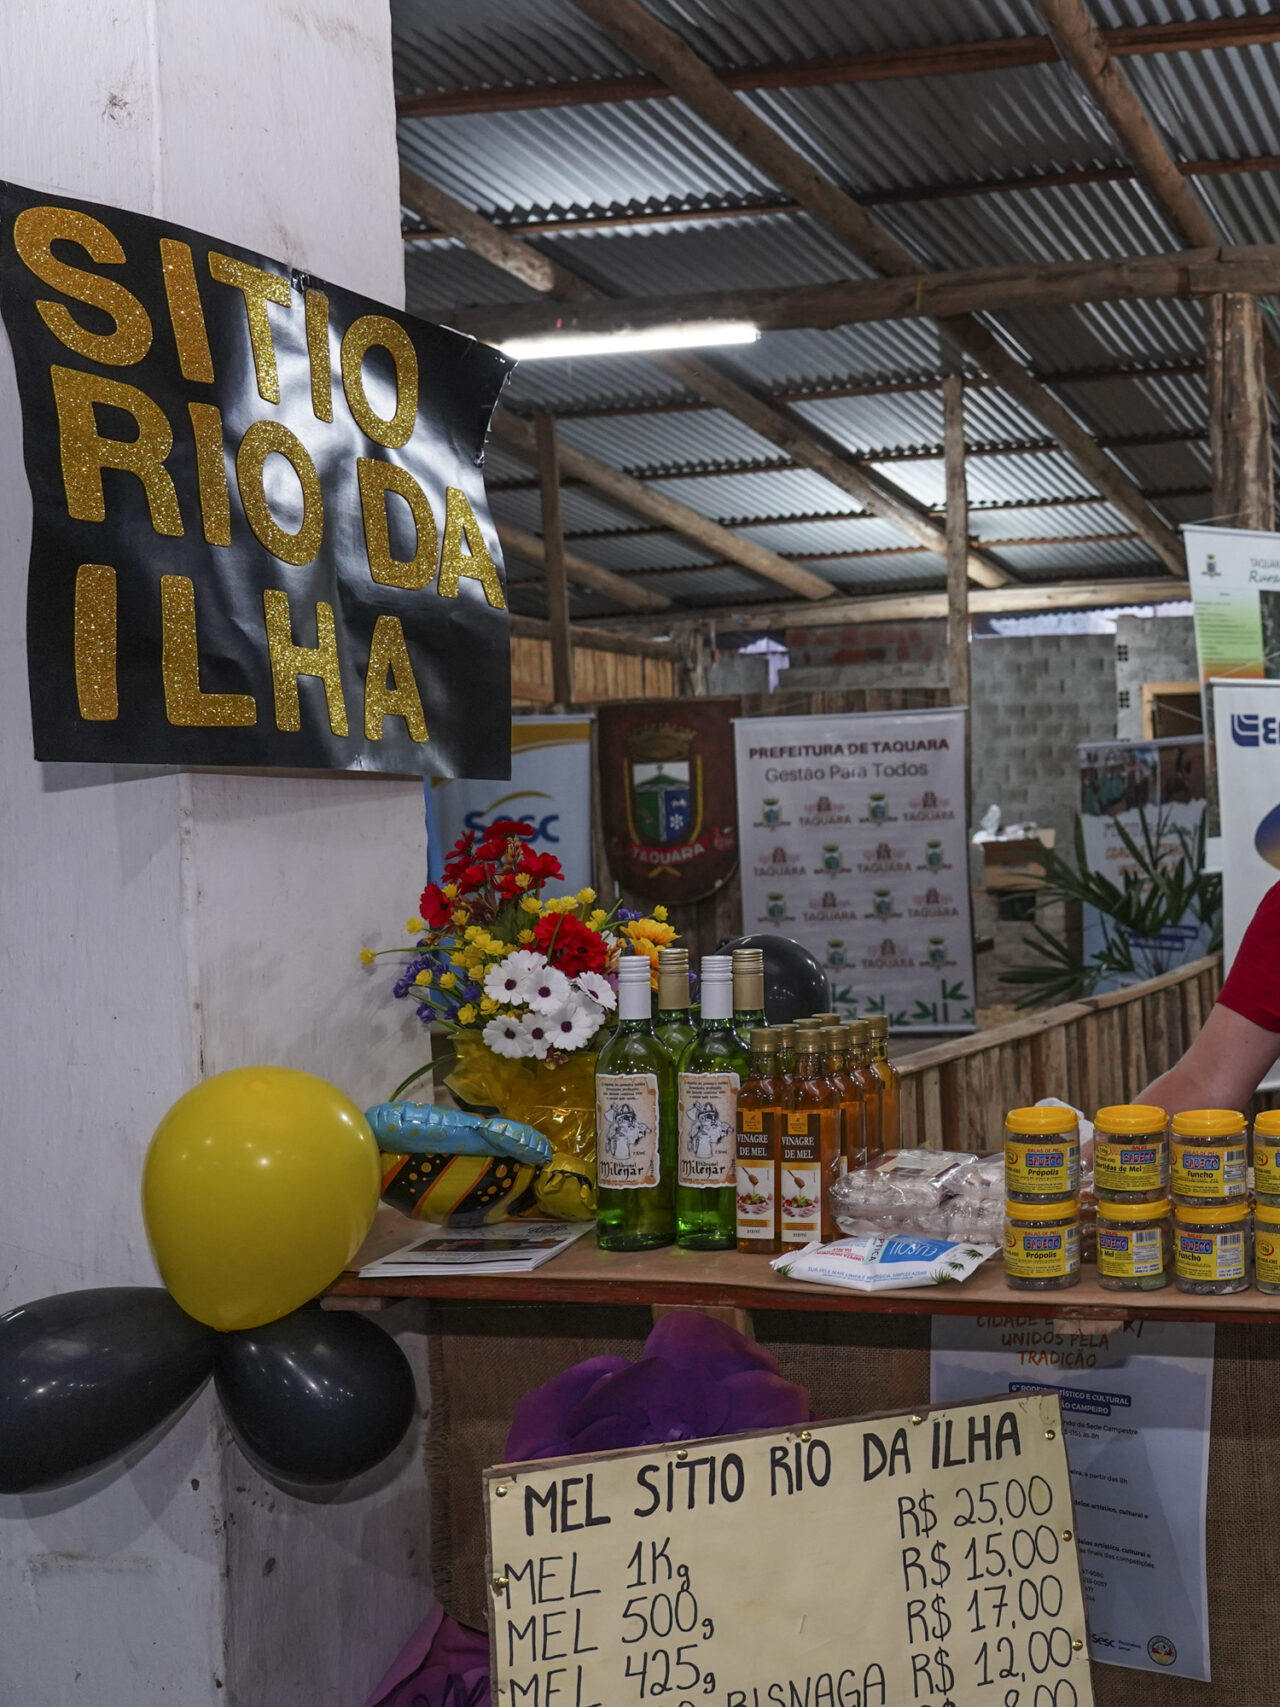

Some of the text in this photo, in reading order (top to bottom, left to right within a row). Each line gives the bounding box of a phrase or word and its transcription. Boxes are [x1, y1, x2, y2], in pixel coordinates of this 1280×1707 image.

[13, 206, 420, 449] SITIO
[50, 364, 508, 610] RIO DA
[74, 563, 430, 744] ILHA
[749, 738, 949, 759] PREFEITURA DE TAQUARA
[765, 761, 928, 784] Gestão Para Todos
[737, 1134, 768, 1143] VINAGRE
[782, 1136, 814, 1145] VINAGRE
[740, 1147, 767, 1156] DE MEL
[785, 1150, 813, 1158] DE MEL
[1028, 1168, 1059, 1176] Própolis
[1187, 1170, 1214, 1179] Funcho
[1026, 1251, 1057, 1260] Própolis
[1178, 1252, 1202, 1262] Funcho
[1002, 1332, 1110, 1350] UNIDOS PELA
[1016, 1349, 1098, 1368] TRADIÇÃO
[1072, 1403, 1109, 1414] CAMPEIRO
[1092, 1394, 1129, 1405] CULTURAL
[1103, 1425, 1138, 1437] Campestre
[524, 1411, 1022, 1537] MEL SITIO RIO DA ILHA
[897, 1475, 1053, 1539] R$ 25,00
[902, 1525, 1059, 1593] R$ 15,00
[504, 1552, 601, 1609] MEL
[907, 1593, 951, 1644] R$
[967, 1575, 1063, 1634] 17,00
[508, 1591, 715, 1666] MEL 500g
[911, 1627, 1072, 1698] R$ 12,00
[510, 1644, 716, 1707] MEL 425g
